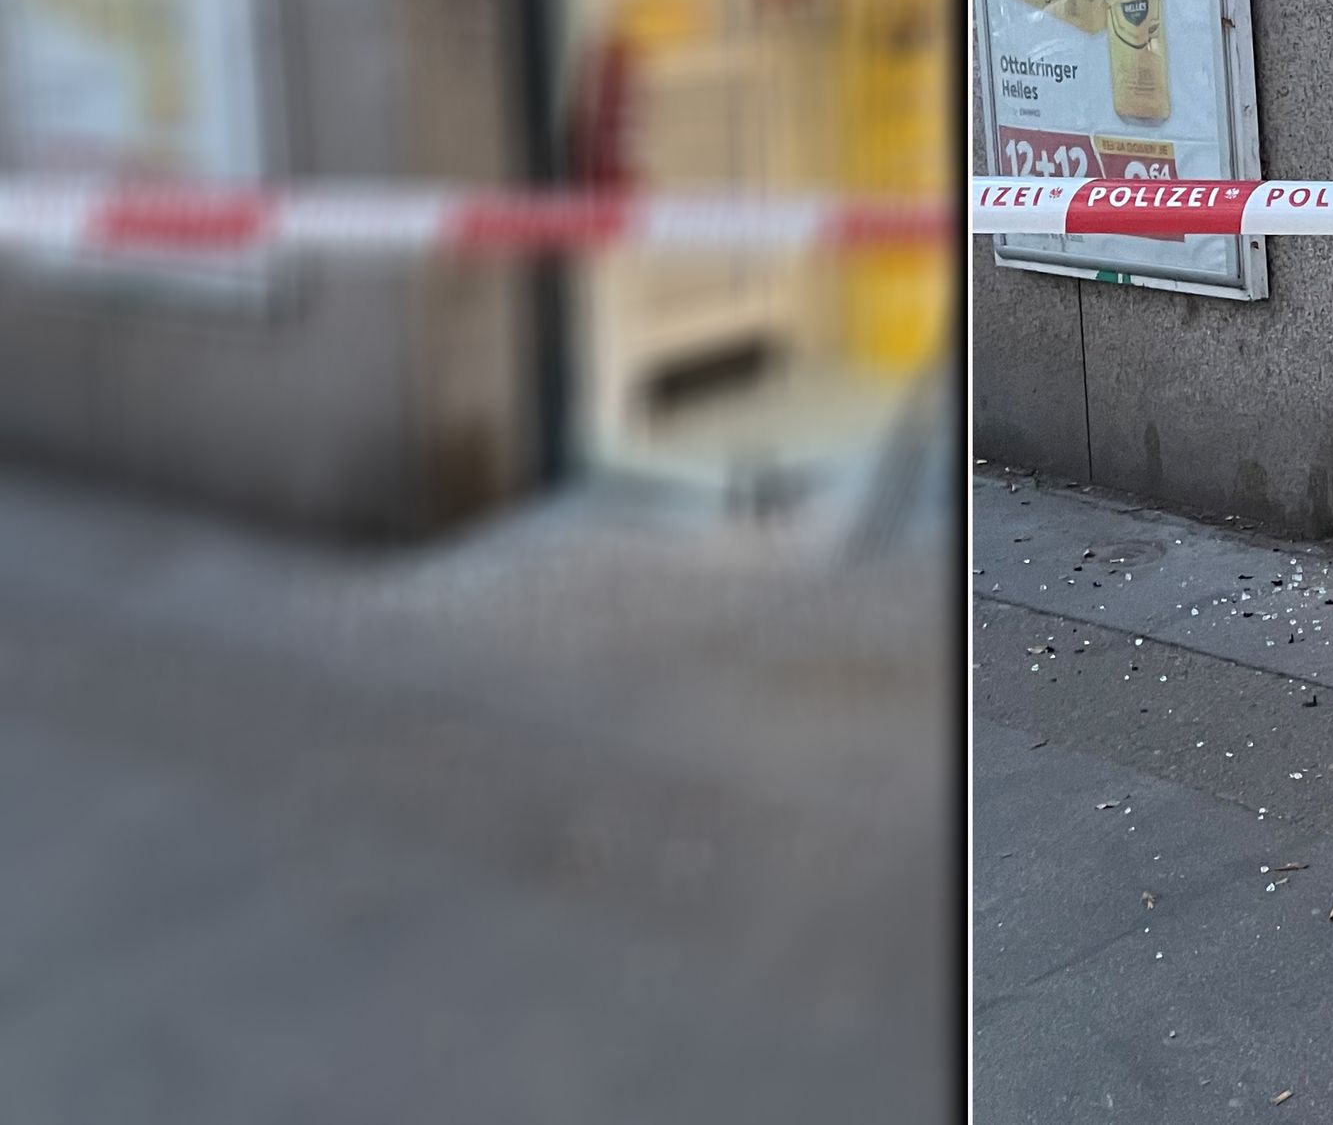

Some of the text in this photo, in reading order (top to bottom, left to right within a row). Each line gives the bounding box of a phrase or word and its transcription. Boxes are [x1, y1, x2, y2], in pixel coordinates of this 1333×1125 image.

[1000, 55, 1078, 83] Ottakringer
[1002, 79, 1039, 100] Helles
[1006, 139, 1088, 177] 12+12
[980, 187, 1044, 207] IZEI
[1087, 187, 1220, 207] POLIZEI
